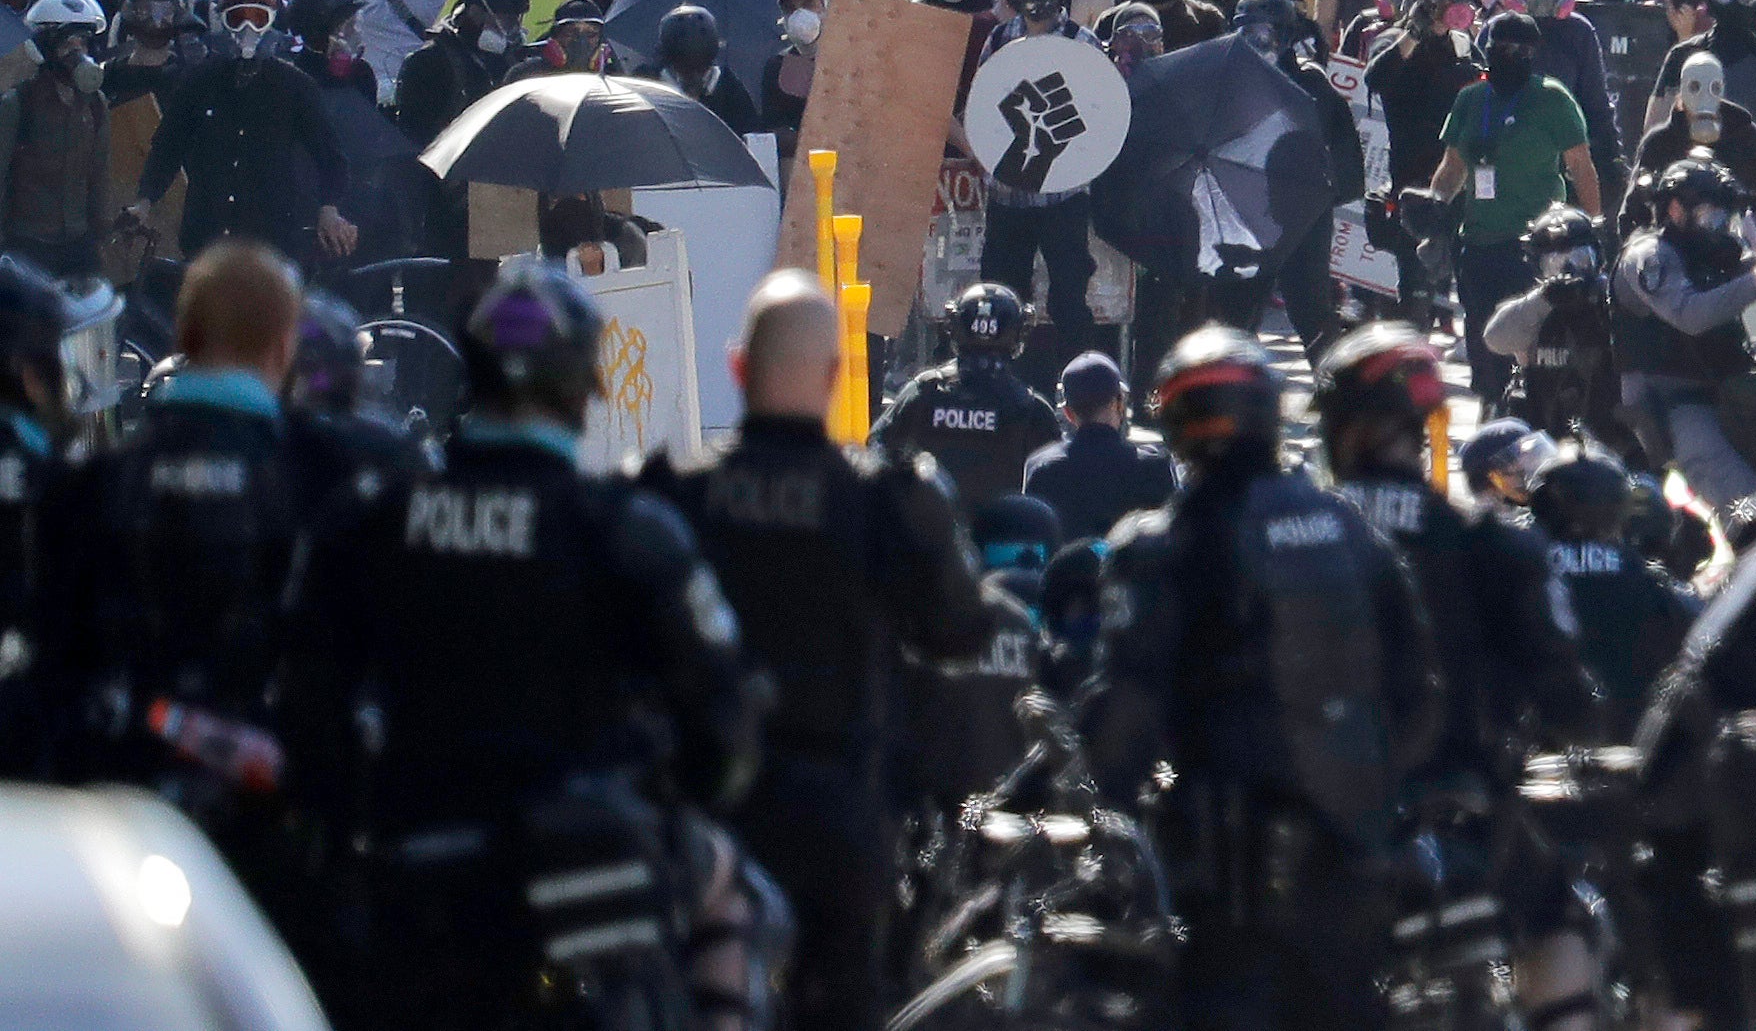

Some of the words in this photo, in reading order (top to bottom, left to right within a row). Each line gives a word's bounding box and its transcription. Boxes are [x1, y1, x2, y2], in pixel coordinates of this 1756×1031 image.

[1331, 223, 1352, 267] FROM
[971, 319, 998, 334] 495
[933, 409, 997, 432] POLICE
[405, 488, 535, 555] POLICE
[1549, 543, 1621, 573] OLICE
